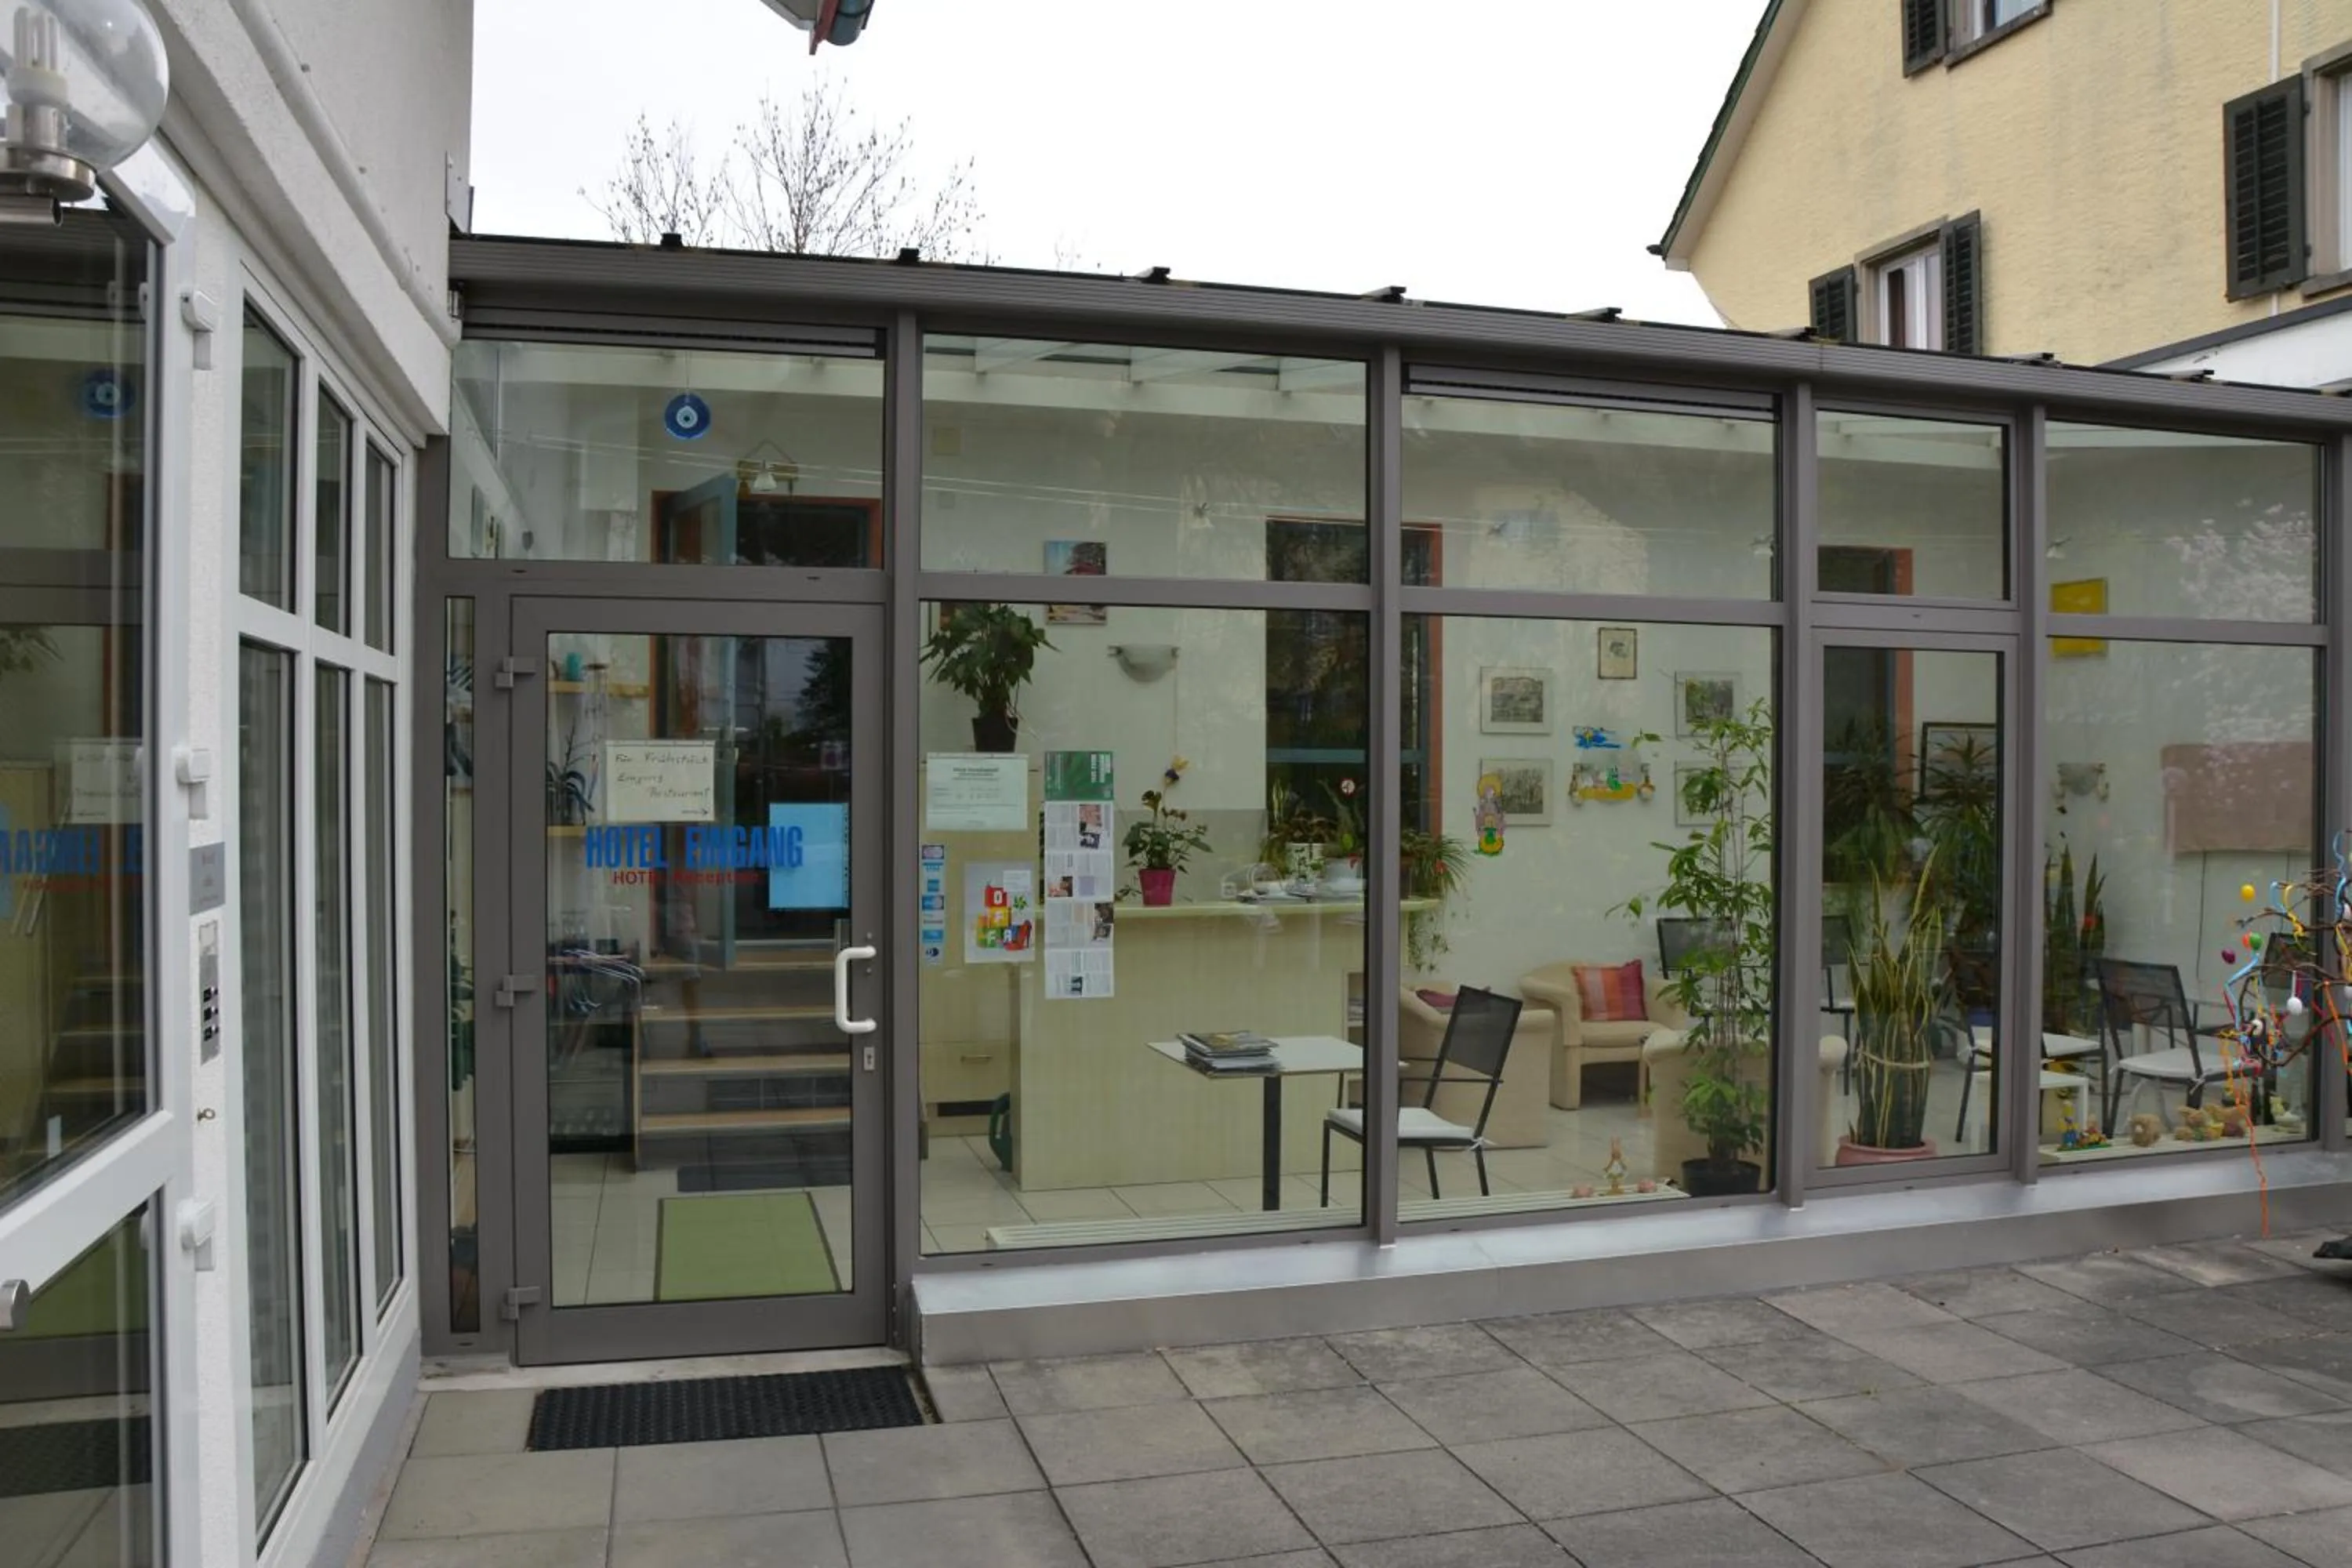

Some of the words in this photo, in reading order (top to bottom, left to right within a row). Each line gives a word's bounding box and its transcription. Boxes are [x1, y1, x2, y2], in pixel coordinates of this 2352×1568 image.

[586, 826, 667, 868] HOTEL
[684, 826, 804, 869] EINGANG
[613, 870, 665, 884] HOTE
